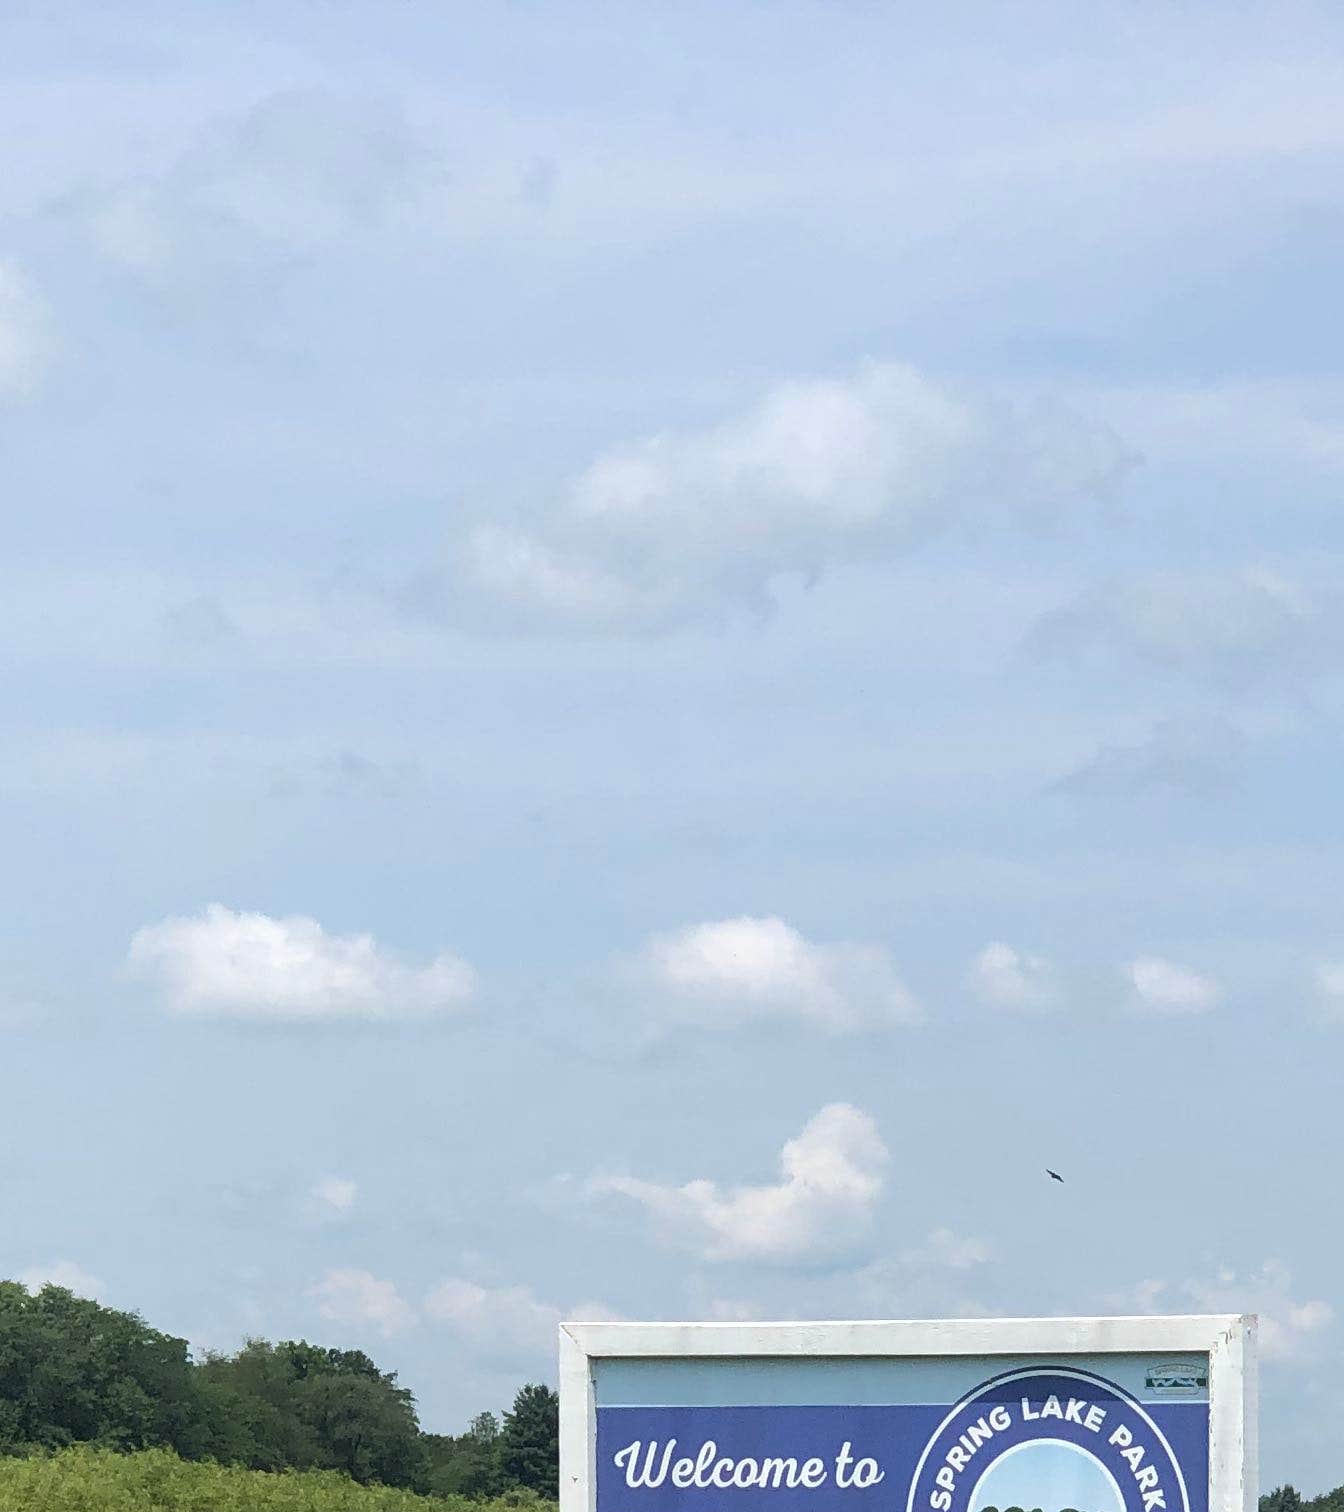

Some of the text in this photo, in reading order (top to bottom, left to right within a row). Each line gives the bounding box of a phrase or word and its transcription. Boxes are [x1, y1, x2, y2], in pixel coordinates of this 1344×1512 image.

[614, 1439, 885, 1488] Welcome to
[930, 1406, 1012, 1512] SPRING
[1021, 1395, 1107, 1433] LAKE
